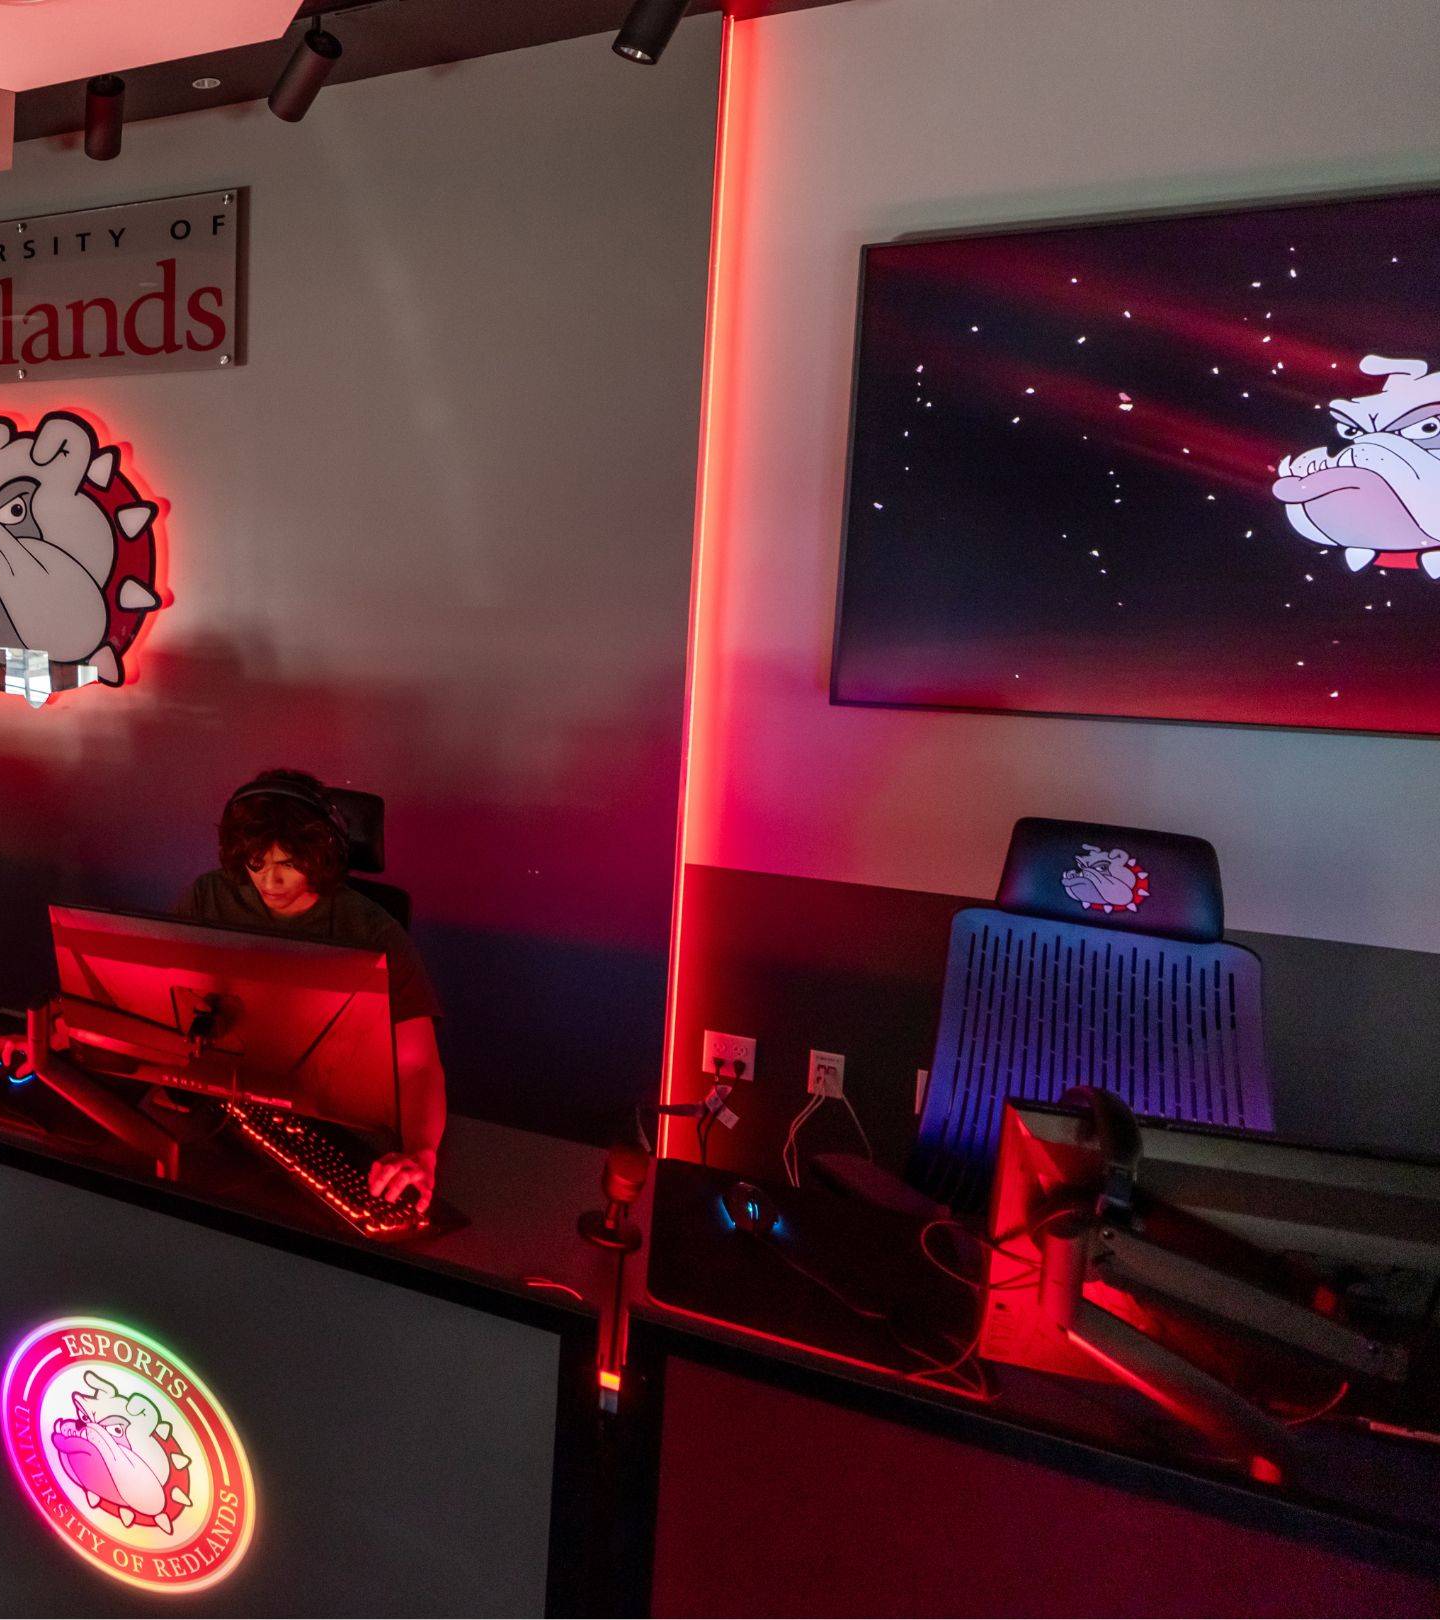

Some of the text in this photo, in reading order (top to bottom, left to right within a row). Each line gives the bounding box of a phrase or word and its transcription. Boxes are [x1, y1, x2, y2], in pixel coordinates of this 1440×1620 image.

[169, 214, 226, 241] OF
[62, 1333, 188, 1399] ESPORTS
[13, 1405, 238, 1578] UNIVERSITY OF REDLANDS
